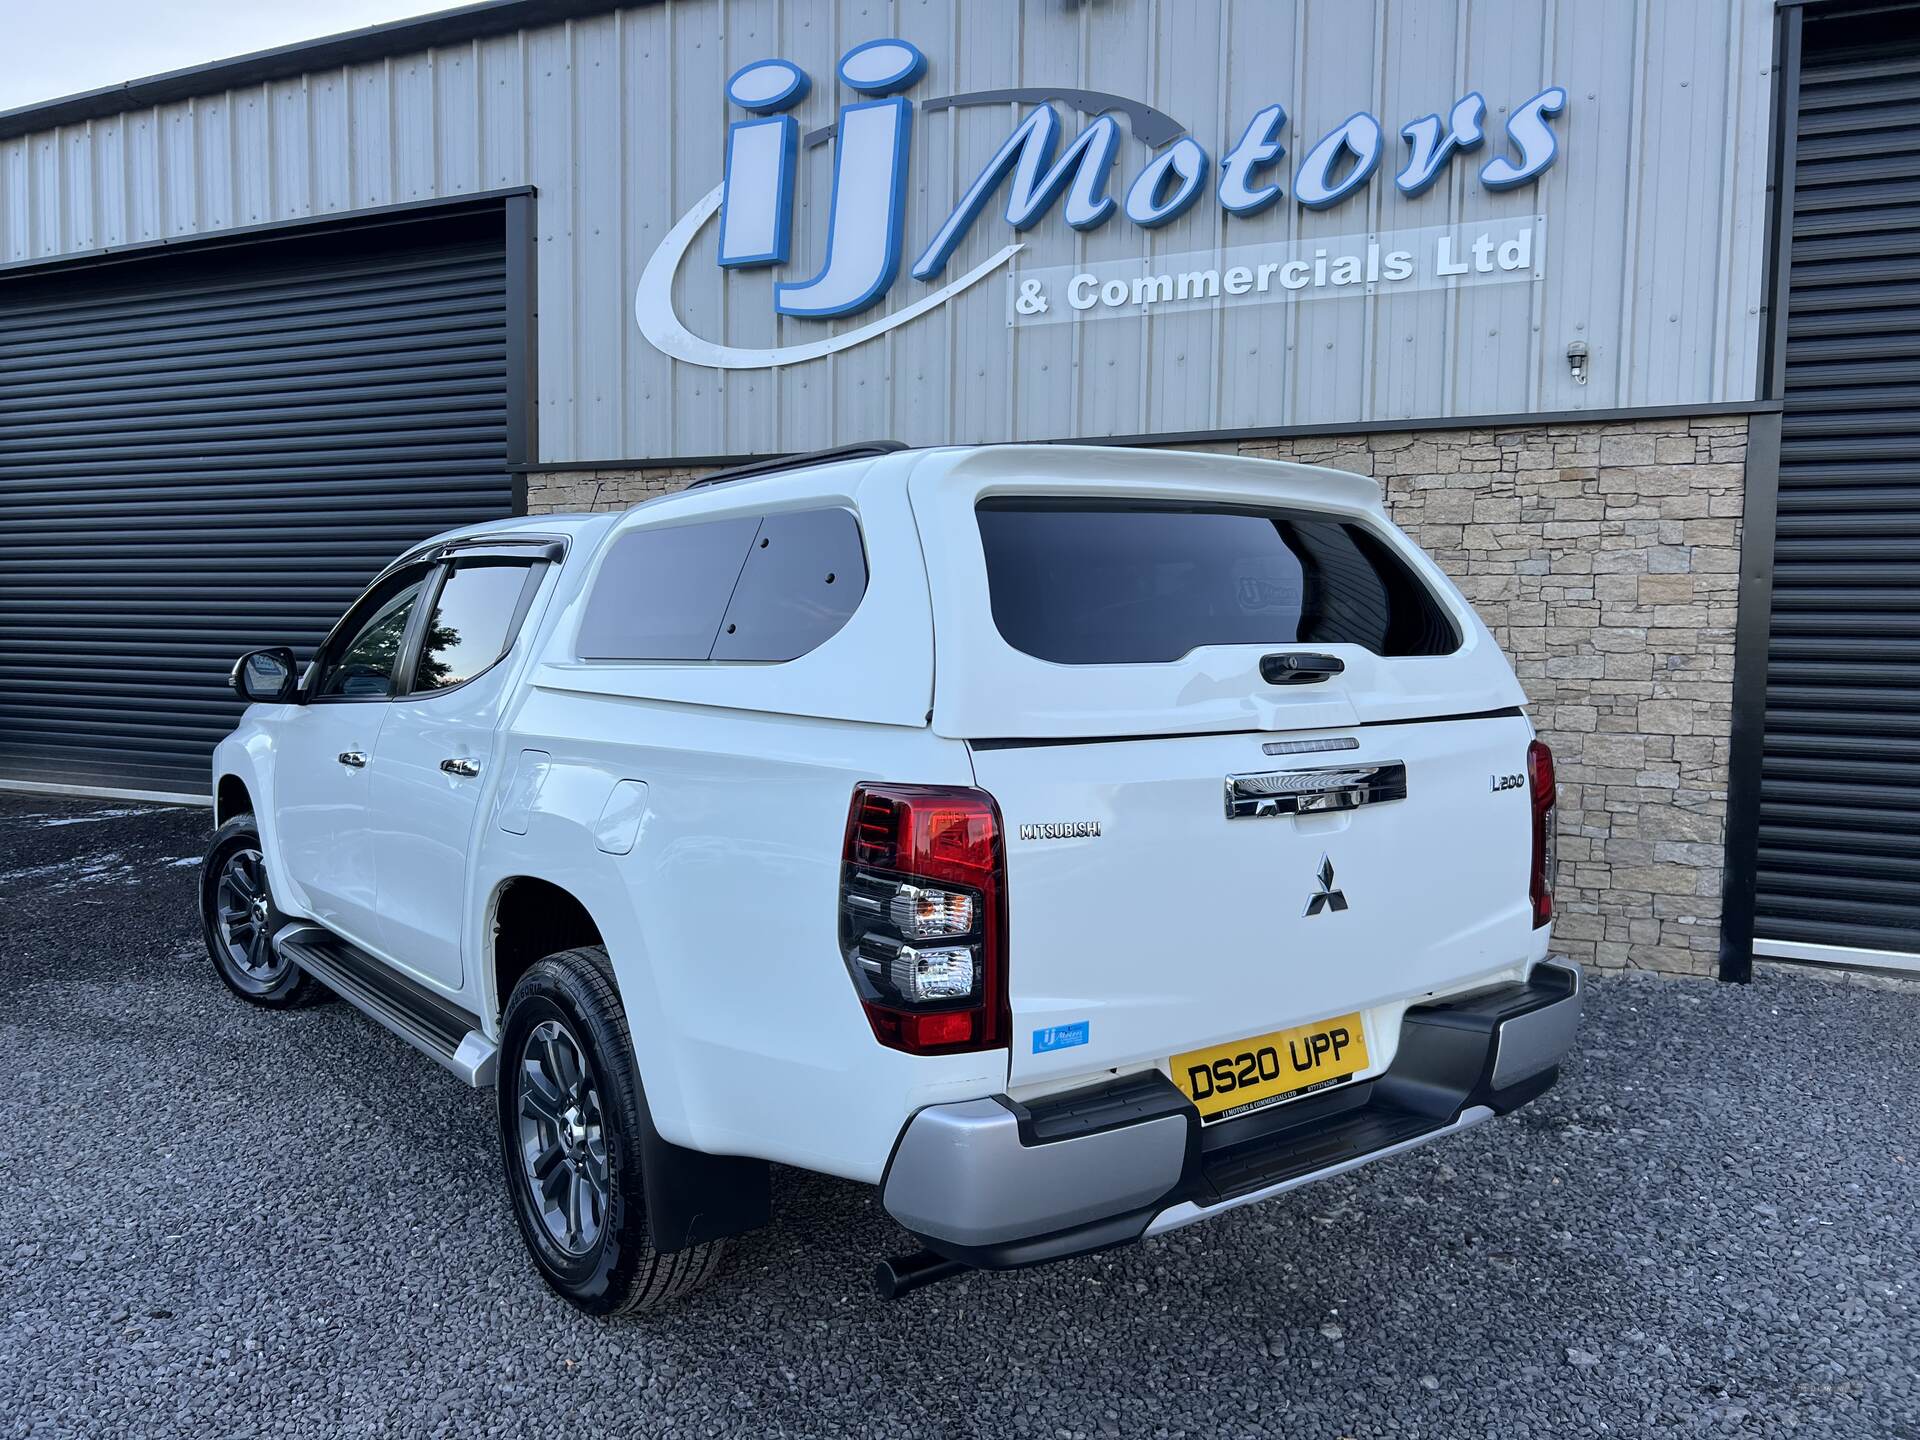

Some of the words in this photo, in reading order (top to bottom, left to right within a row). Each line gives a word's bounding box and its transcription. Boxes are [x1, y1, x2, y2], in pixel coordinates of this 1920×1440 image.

[912, 87, 1566, 281] Motors
[1015, 278, 1049, 315] &
[1068, 244, 1413, 310] Commercials
[1437, 228, 1532, 276] Ltd
[1490, 773, 1524, 792] L200
[1020, 821, 1101, 840] MITSUBISHI
[1188, 1047, 1280, 1101] DS20
[1289, 1028, 1350, 1071] UPP
